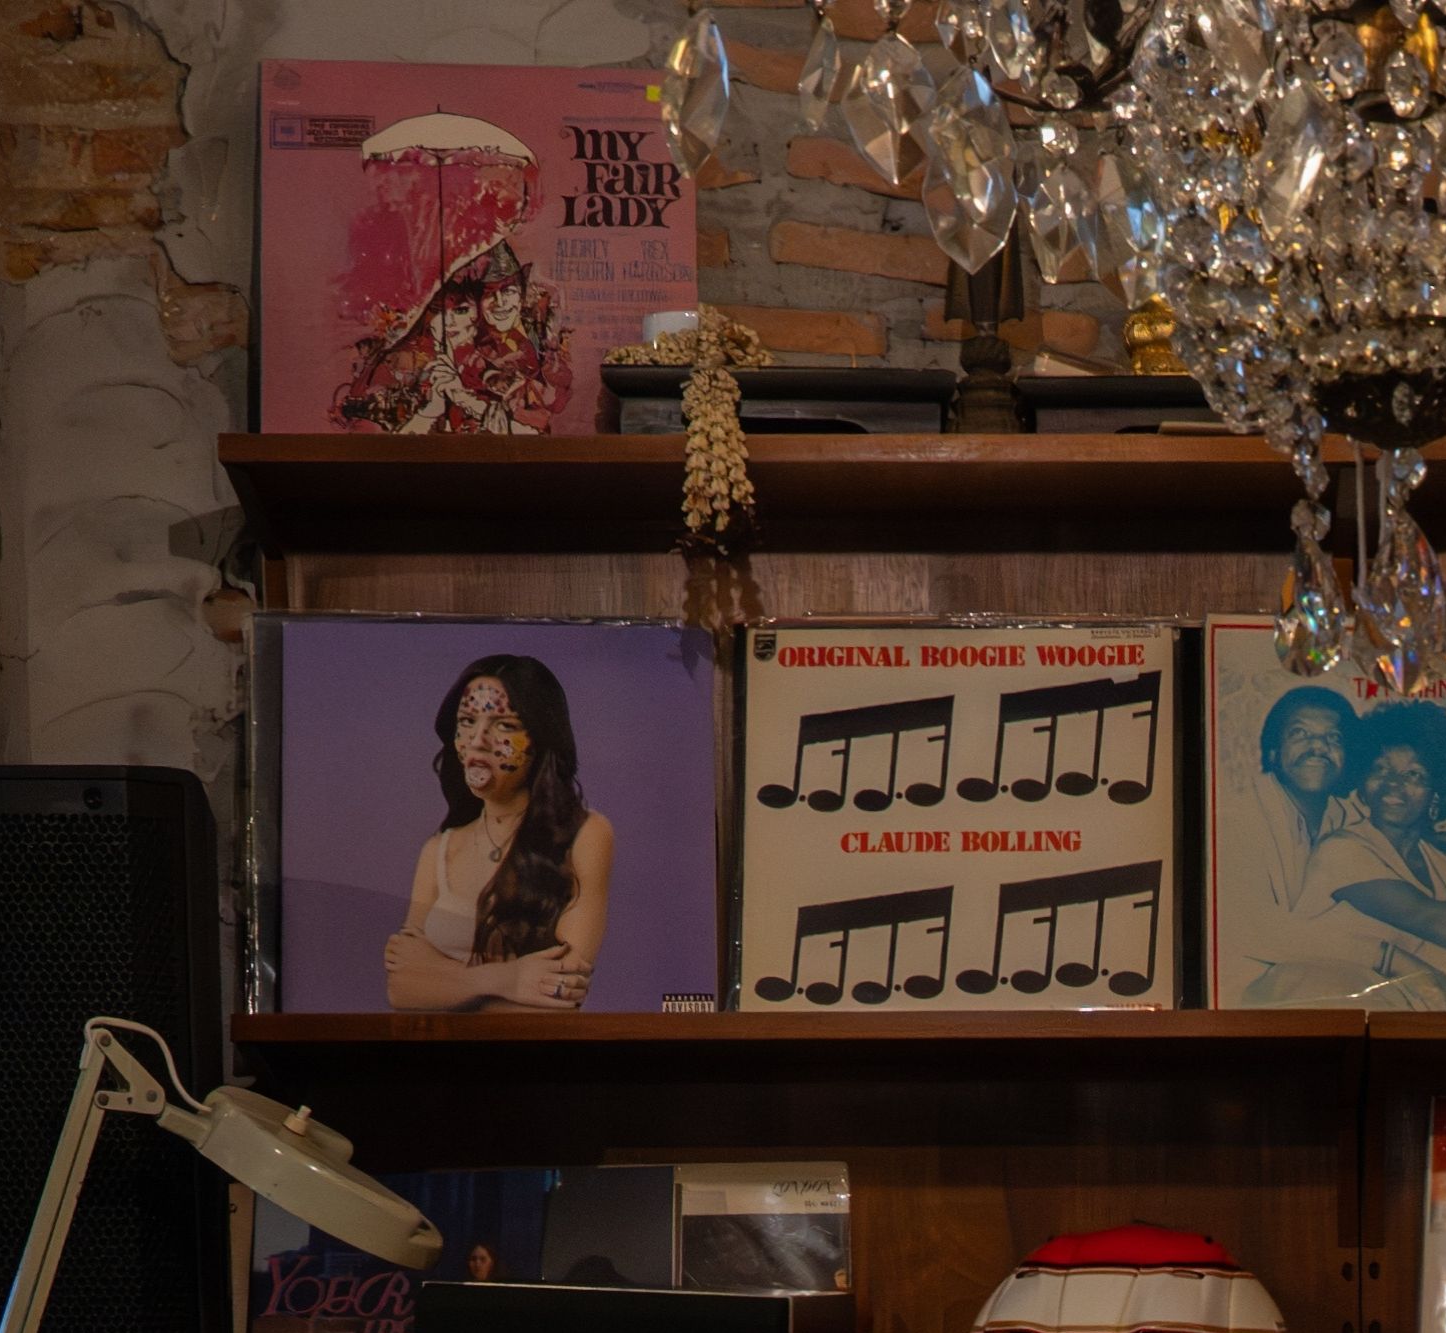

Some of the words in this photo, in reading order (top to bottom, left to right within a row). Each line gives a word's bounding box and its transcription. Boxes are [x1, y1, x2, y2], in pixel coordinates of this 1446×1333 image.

[778, 645, 910, 668] ORIGINAL
[922, 645, 1026, 667] BOOGIE
[1036, 644, 1145, 666] WOOGIE
[840, 832, 951, 853] CLAUDE
[961, 830, 1082, 852] BOLLING
